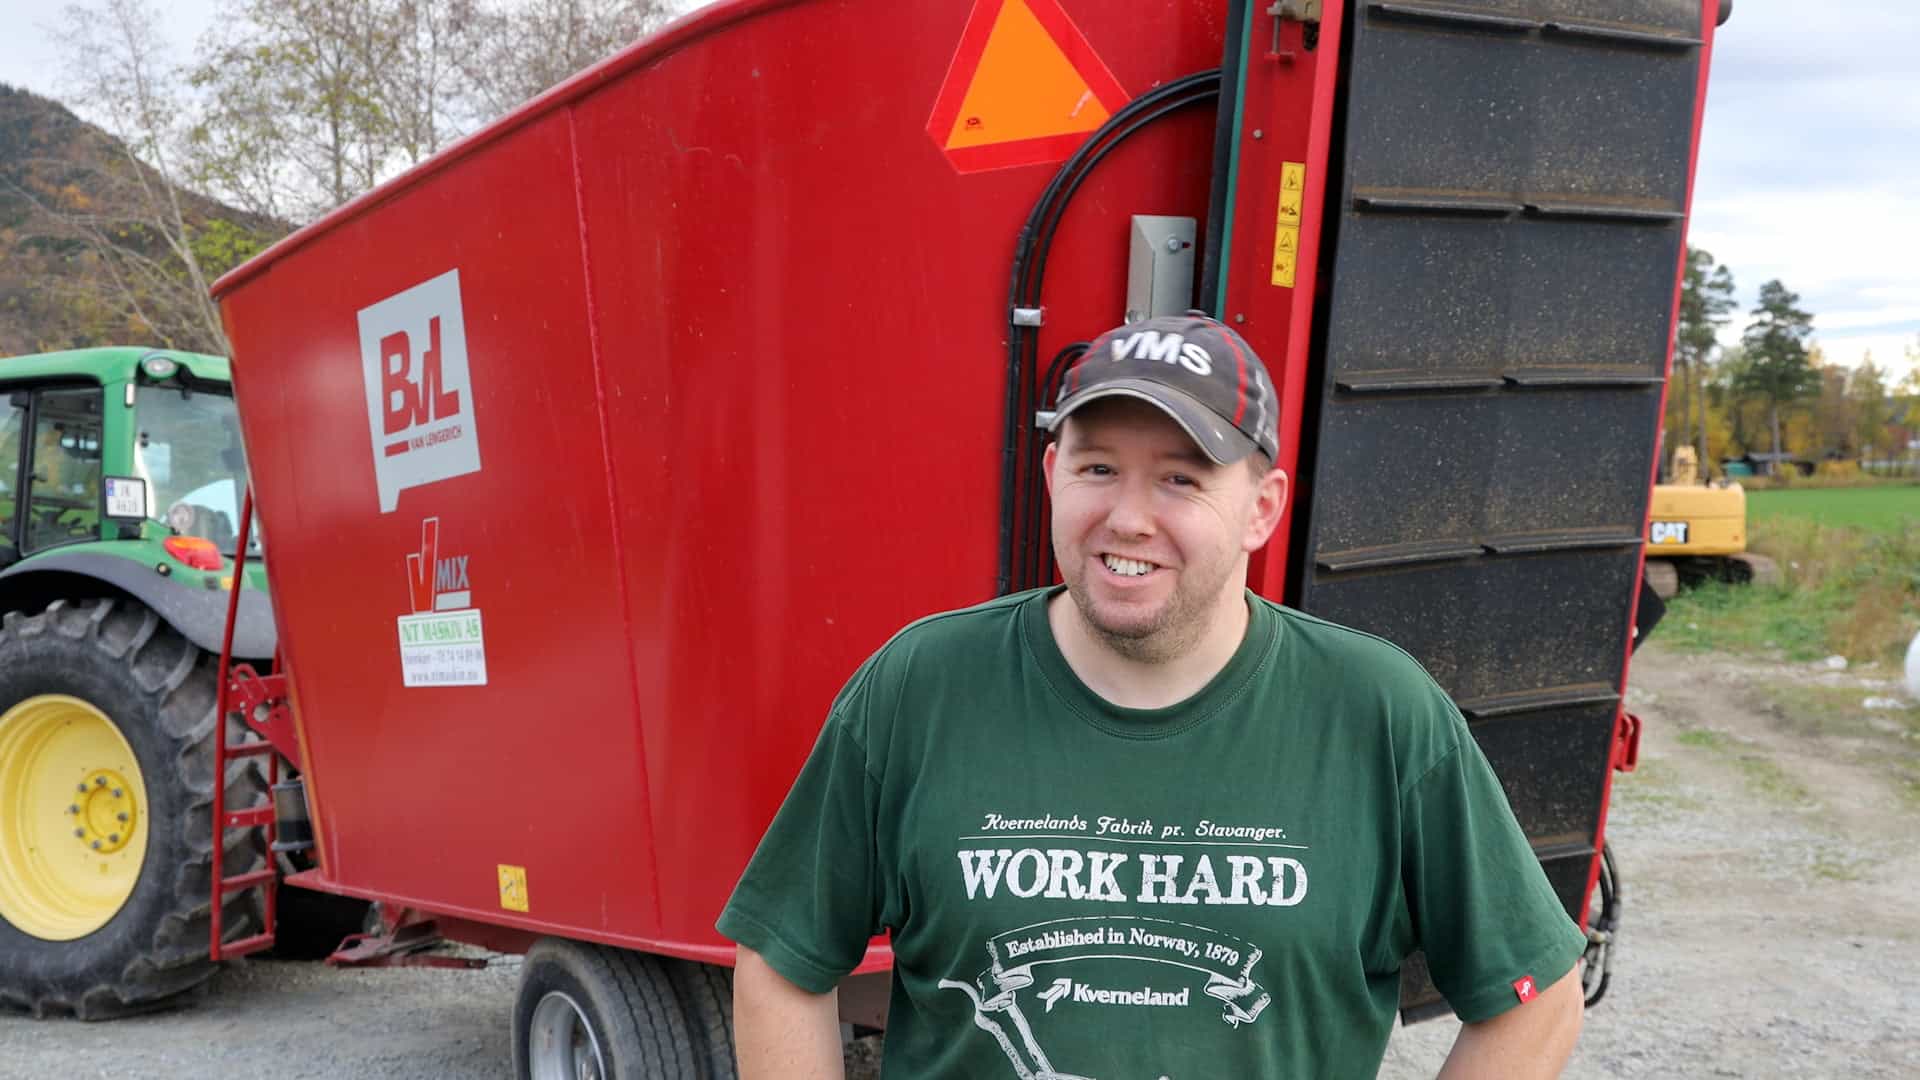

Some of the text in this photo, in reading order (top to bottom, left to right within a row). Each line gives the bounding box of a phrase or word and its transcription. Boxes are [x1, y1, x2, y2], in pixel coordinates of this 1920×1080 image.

[1111, 330, 1212, 376] VMS
[411, 436, 425, 450] VAN
[1651, 521, 1687, 544] CAT
[465, 616, 480, 639] AS
[981, 813, 1287, 841] Kvernelands Fabrik pr. Stavanger.
[957, 848, 1308, 906] WORK HARD
[1005, 927, 1240, 966] Established in Norway, 1879
[1073, 983, 1189, 1006] Kverneland
